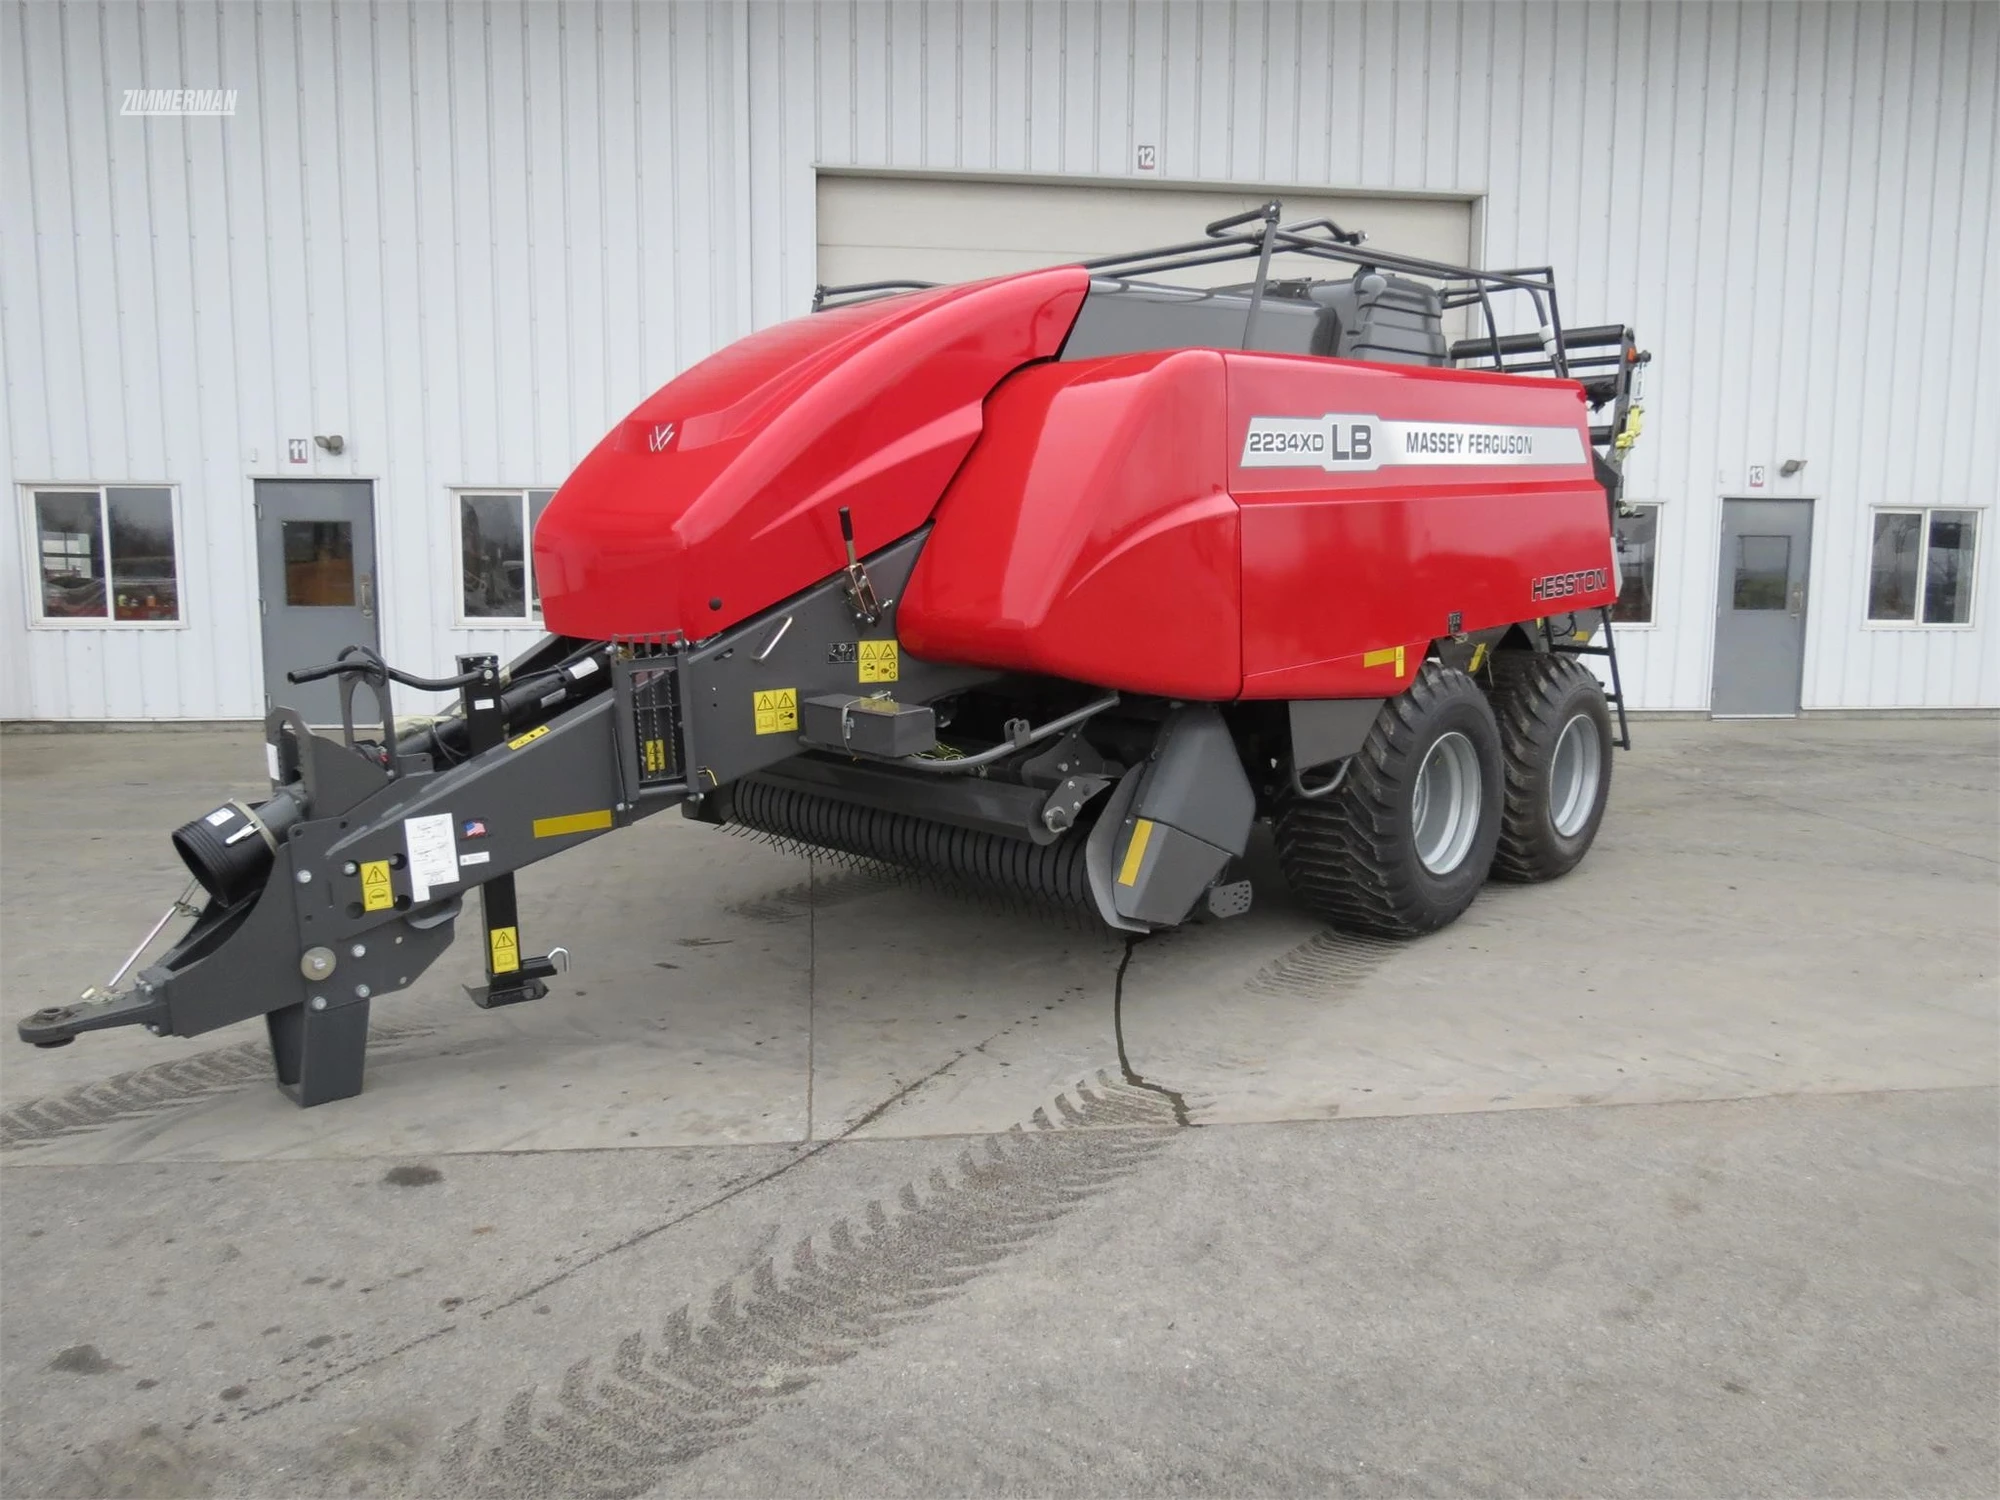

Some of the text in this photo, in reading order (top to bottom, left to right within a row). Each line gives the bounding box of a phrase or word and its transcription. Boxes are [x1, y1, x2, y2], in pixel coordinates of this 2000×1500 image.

[1138, 147, 1154, 166] 12
[290, 440, 307, 460] 11
[1249, 432, 1324, 452] 2234XD
[1332, 424, 1372, 460] LB
[1406, 431, 1533, 454] MASSEY FERGUSON
[1750, 467, 1764, 484] 13
[1531, 567, 1607, 602] HESSTON
